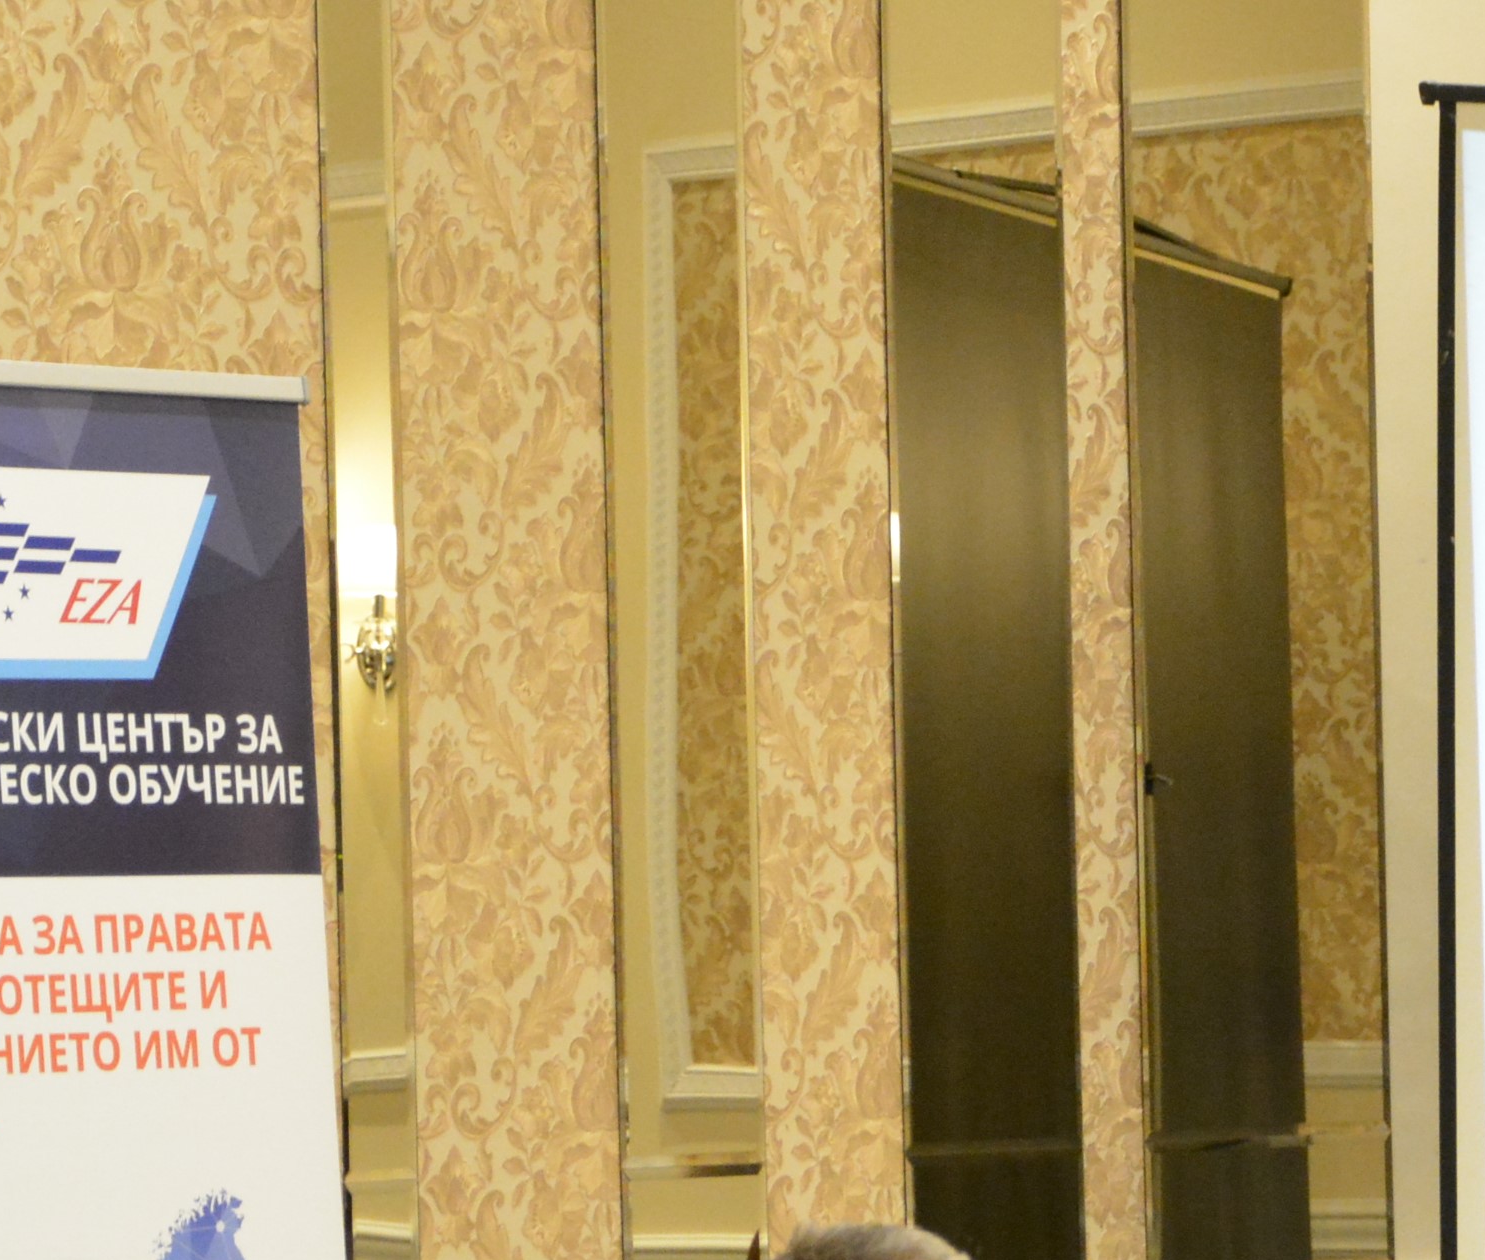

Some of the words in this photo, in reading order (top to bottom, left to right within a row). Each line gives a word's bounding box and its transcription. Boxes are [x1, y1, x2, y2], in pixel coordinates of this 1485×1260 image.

[60, 579, 141, 624] EZA
[78, 712, 225, 763] ЦЕНТЪР
[236, 714, 282, 753] ЗА
[109, 764, 304, 804] ОБУЧЕНИЕ
[33, 915, 83, 955] ЗА
[95, 912, 271, 953] ПРАВАТА
[200, 971, 227, 1009] И
[135, 1029, 199, 1070] ИМ
[213, 1027, 261, 1067] ОТ
